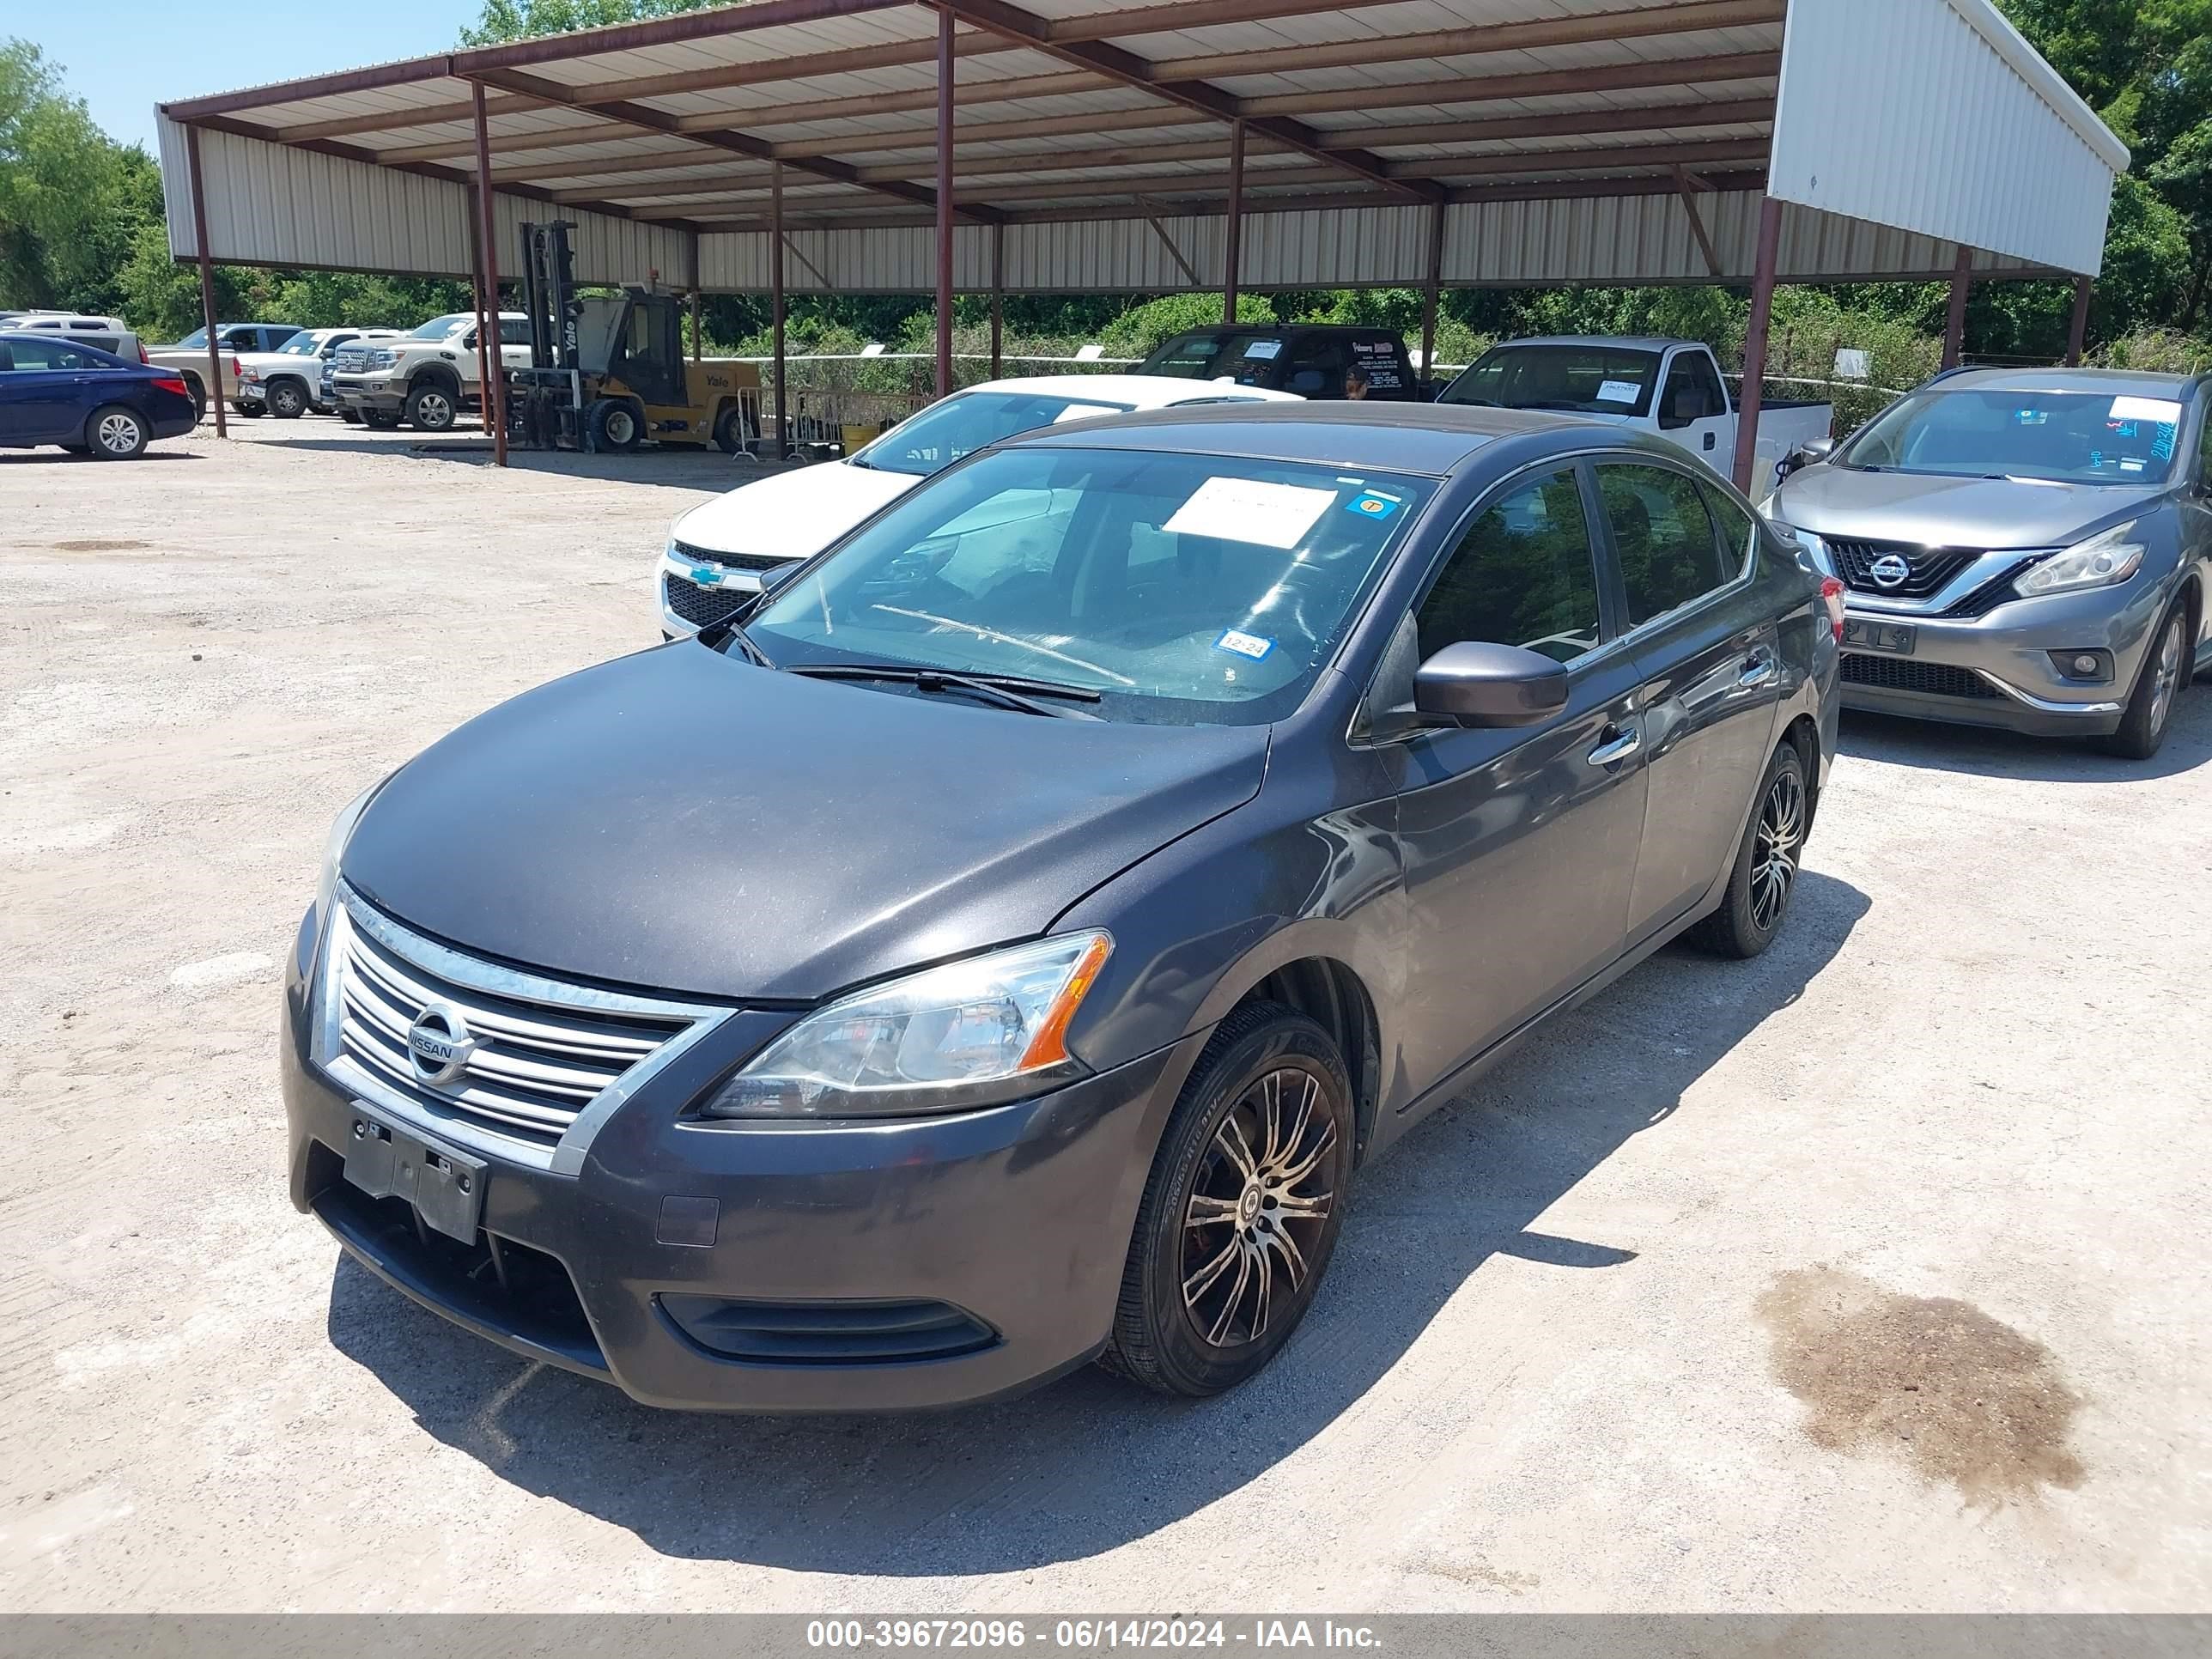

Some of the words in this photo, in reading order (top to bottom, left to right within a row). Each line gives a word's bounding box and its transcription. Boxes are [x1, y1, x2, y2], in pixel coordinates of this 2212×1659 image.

[565, 321, 576, 351] Yale
[707, 375, 729, 387] Yale
[1873, 567, 1905, 576] NISSAN
[408, 1034, 453, 1058] NISSAN
